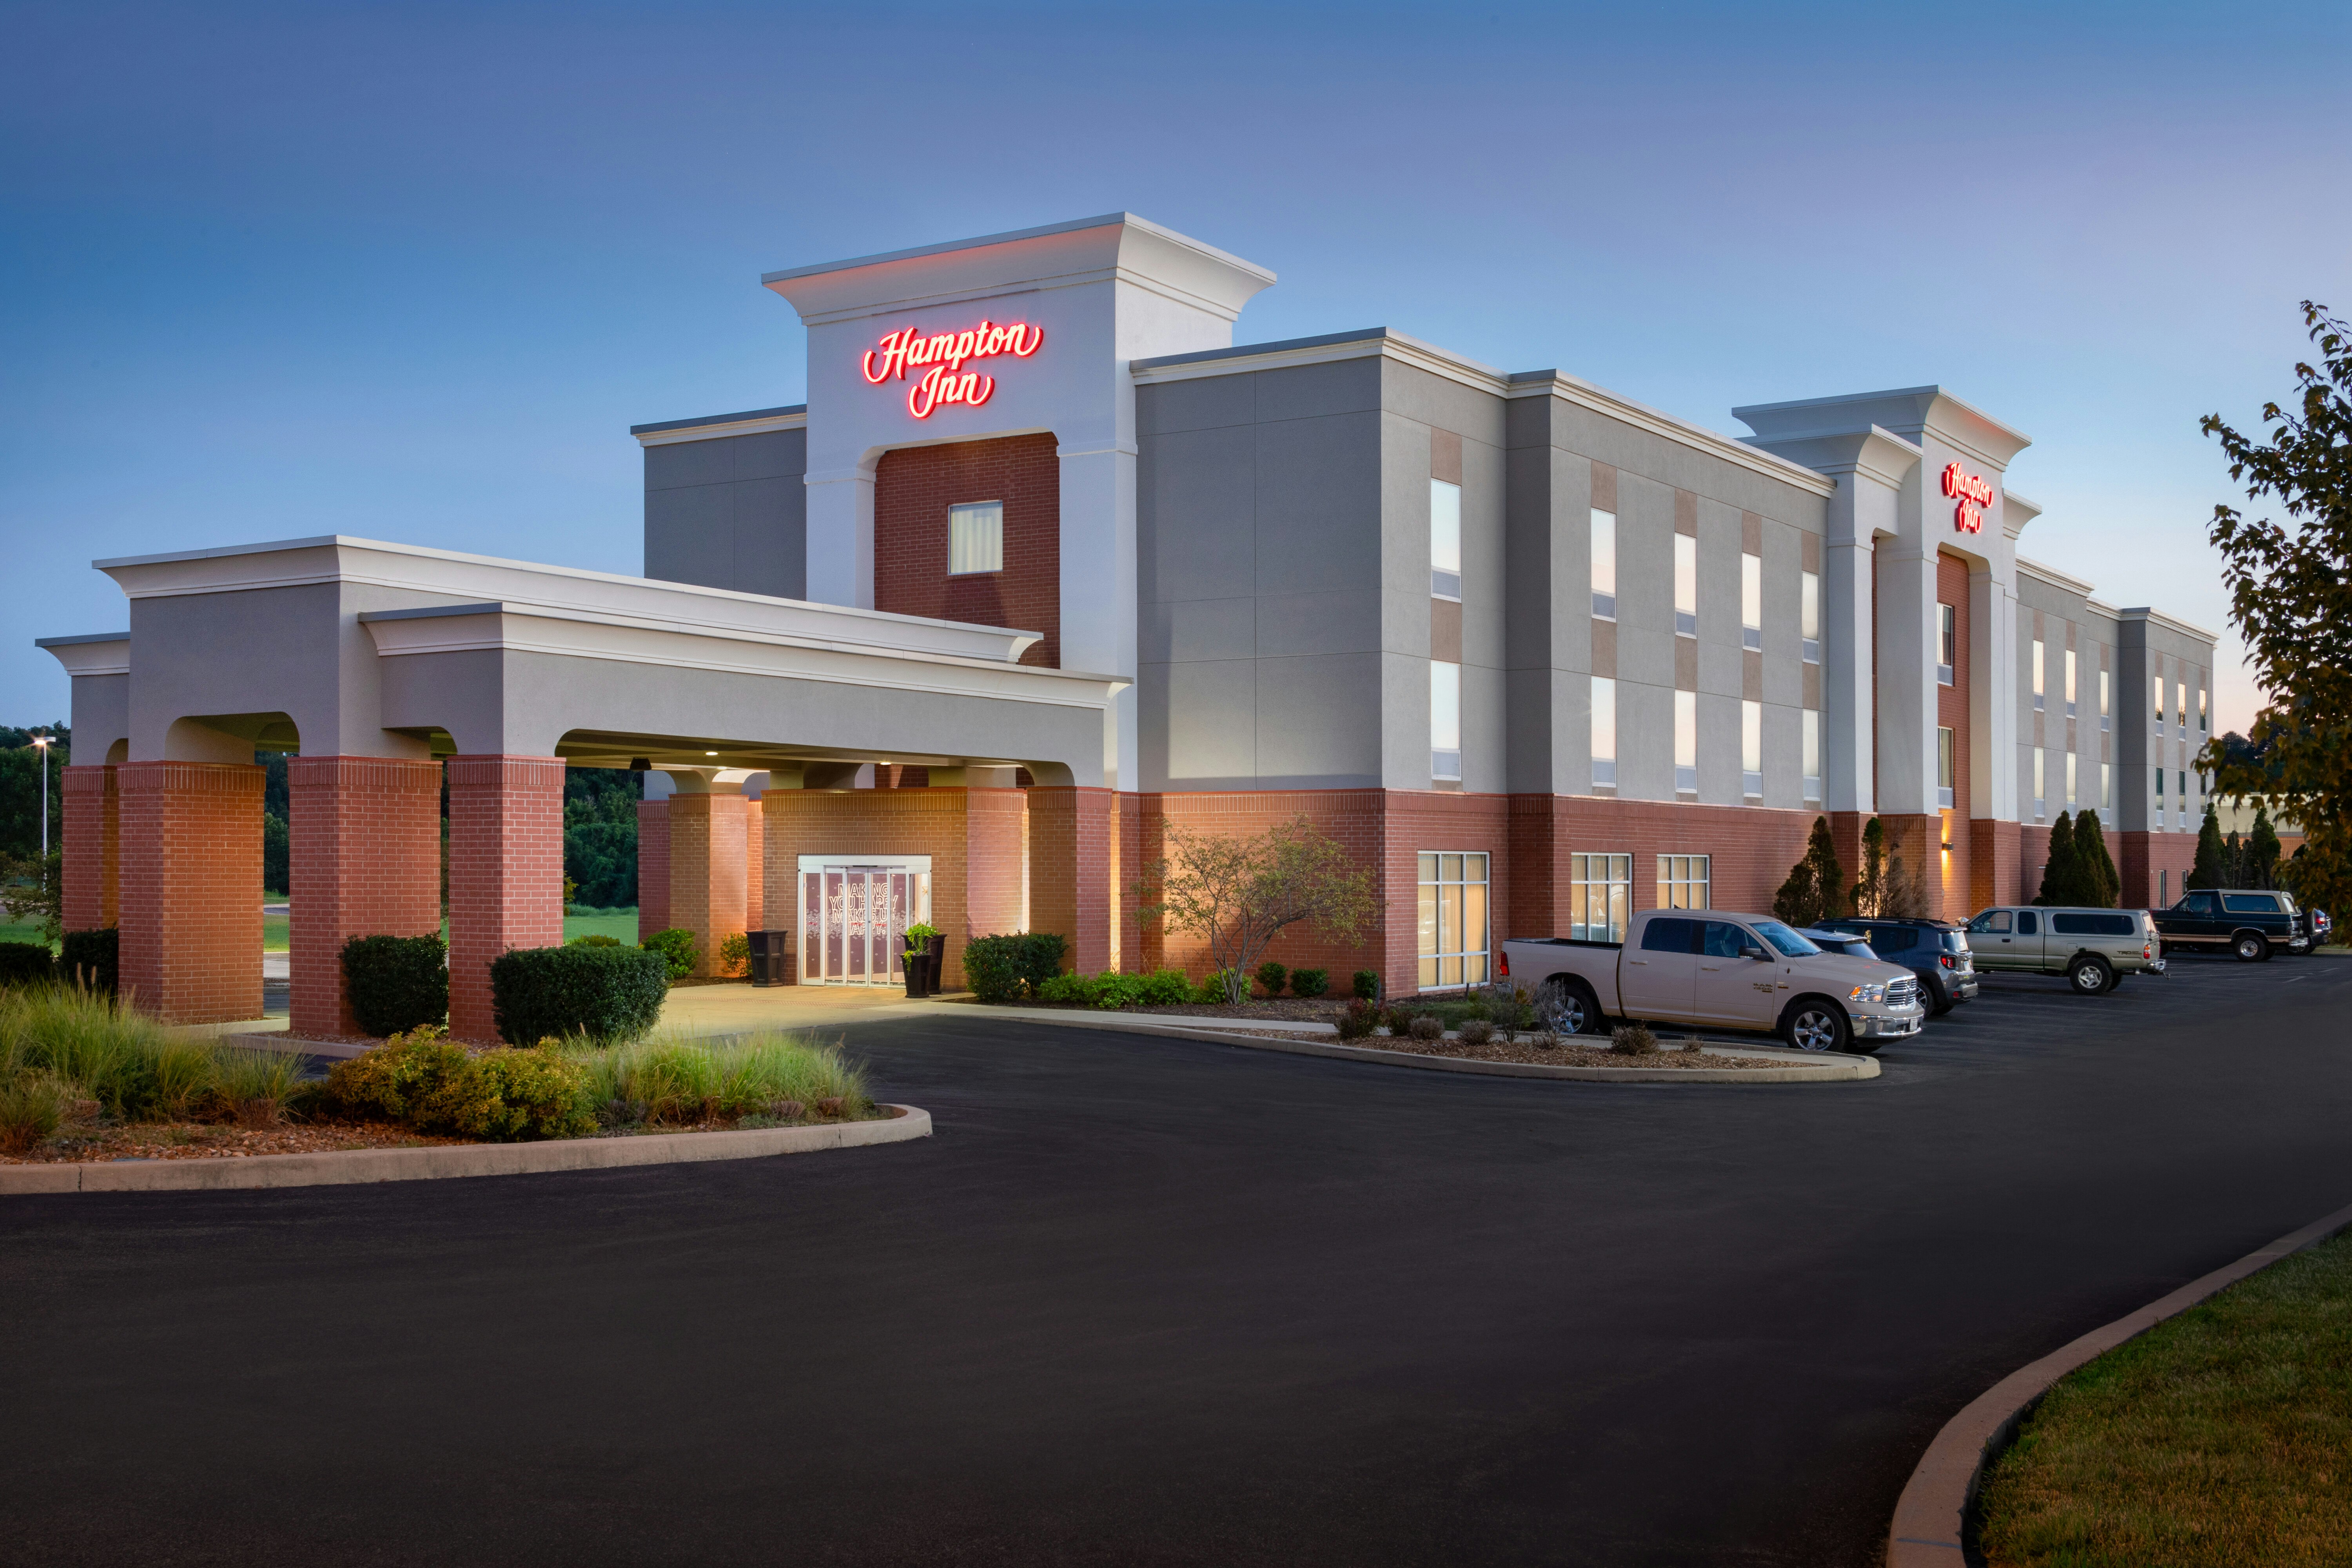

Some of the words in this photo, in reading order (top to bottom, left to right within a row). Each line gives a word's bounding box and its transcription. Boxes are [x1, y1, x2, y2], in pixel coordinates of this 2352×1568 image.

[863, 321, 1043, 383] Hampton
[909, 365, 995, 418] Inn
[1944, 463, 1993, 508] Hampton
[1957, 498, 1982, 533] Inn
[838, 883, 888, 897] MAKNG
[879, 907, 895, 922] U
